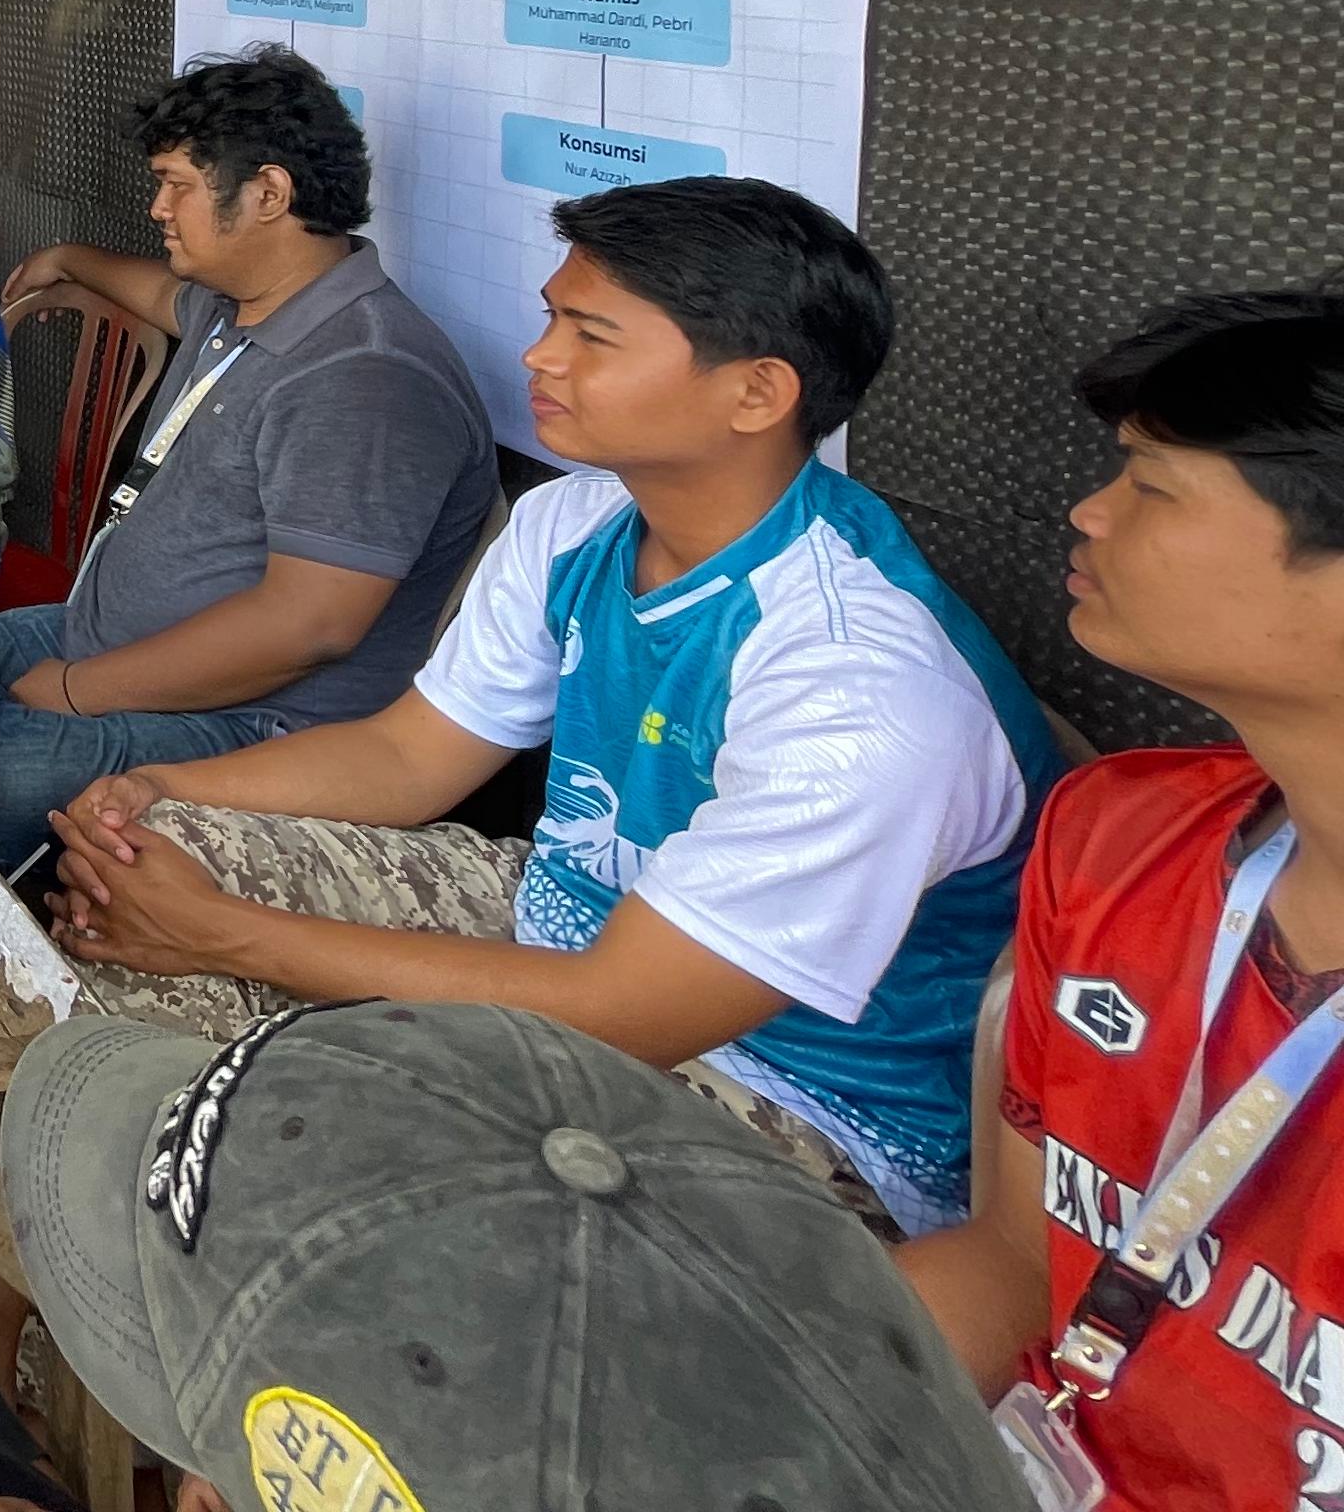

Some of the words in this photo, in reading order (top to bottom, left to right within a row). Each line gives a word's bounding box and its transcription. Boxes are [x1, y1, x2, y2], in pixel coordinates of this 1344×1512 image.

[527, 5, 606, 25] Muhammad
[608, 11, 649, 30] Dandi,
[652, 15, 694, 32] Pebri
[579, 31, 632, 50] Harianto
[558, 131, 647, 164] Konsumsi
[564, 161, 588, 178] Nur
[589, 166, 632, 187] Azizah
